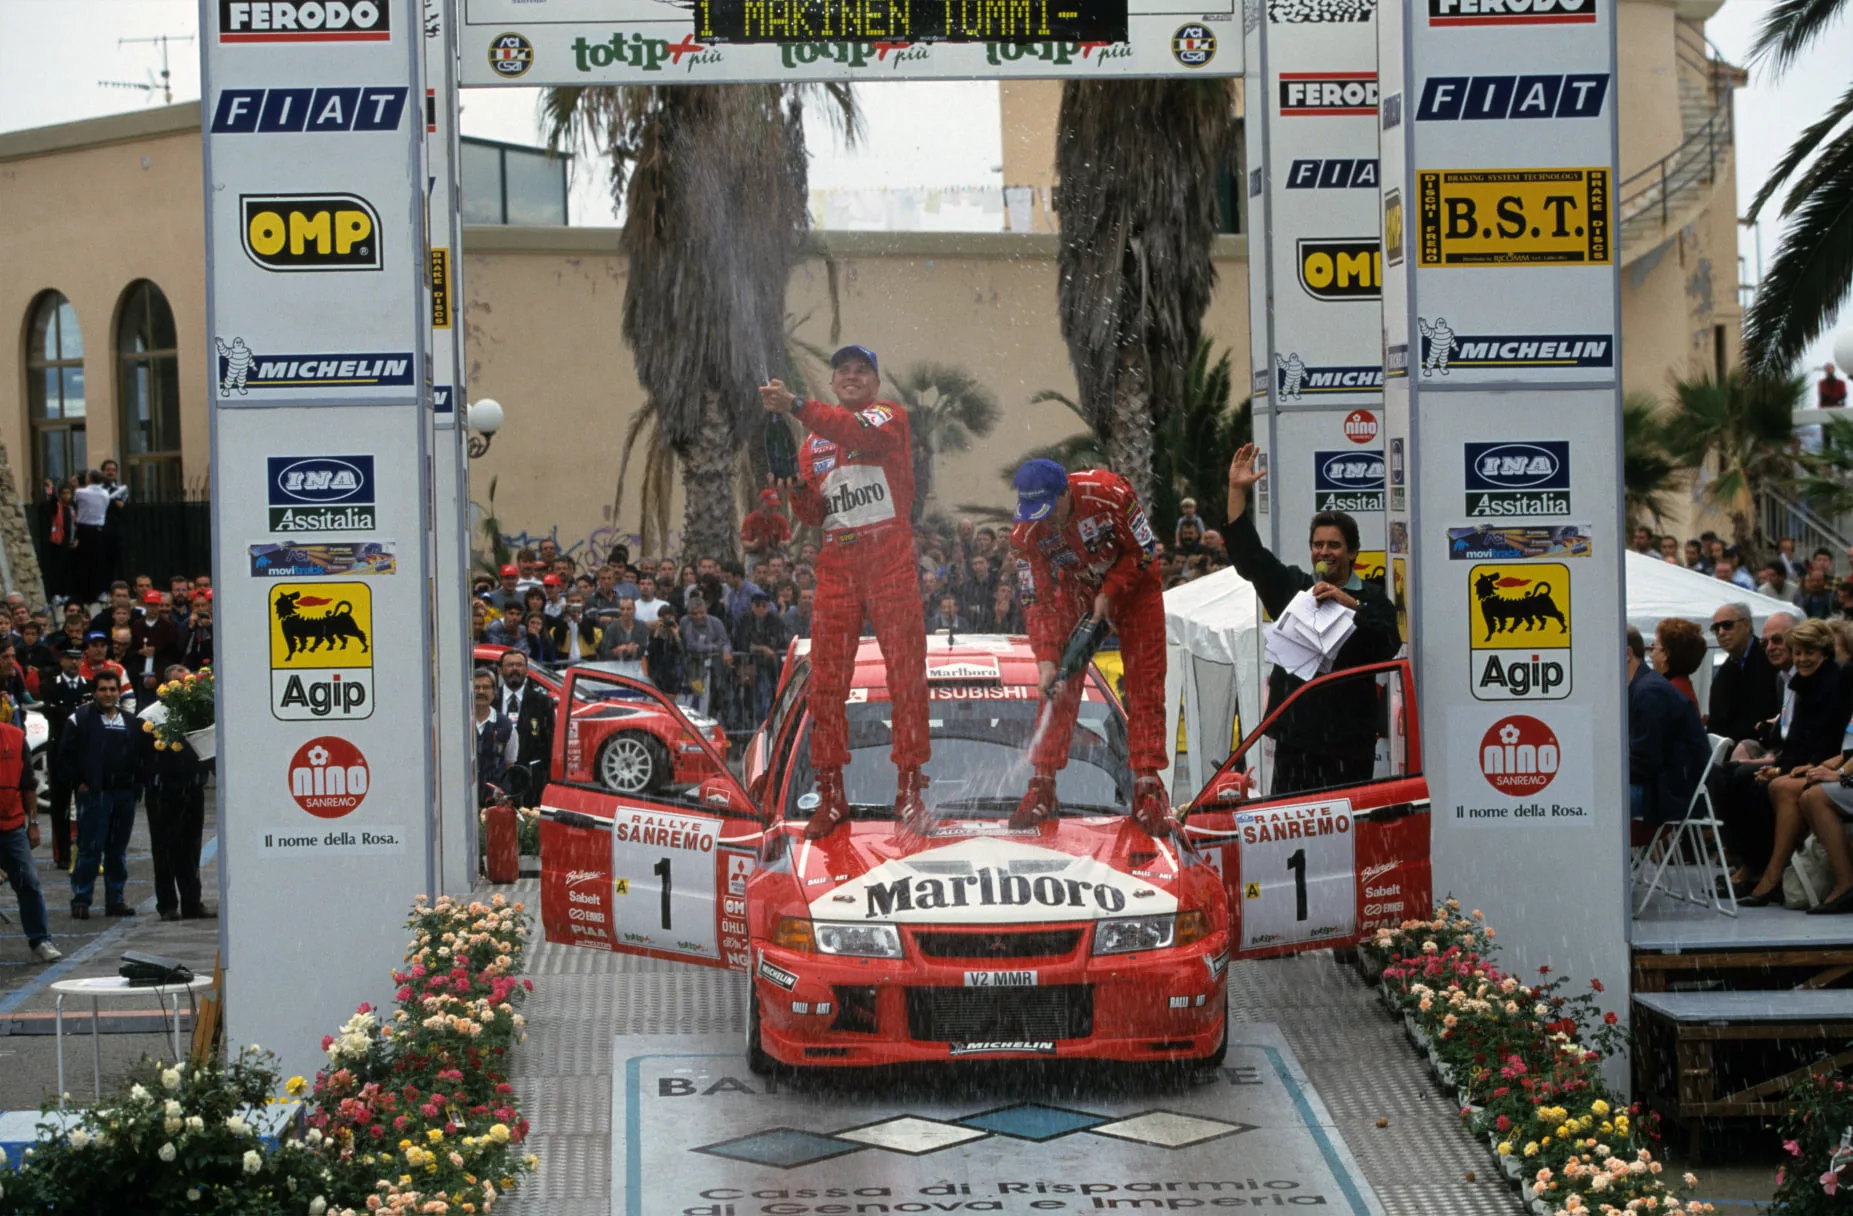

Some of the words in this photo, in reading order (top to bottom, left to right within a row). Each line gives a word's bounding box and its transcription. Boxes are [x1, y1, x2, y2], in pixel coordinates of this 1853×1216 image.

[229, 1, 380, 30] FERODO
[745, 0, 910, 36] MAKINEN
[1288, 83, 1378, 106] FEROD
[1430, 82, 1597, 113] FIAT
[226, 95, 395, 125] FIAT
[1296, 164, 1376, 184] FIA
[1447, 174, 1485, 182] BRAKING
[1488, 173, 1520, 181] SYSTEM
[1524, 172, 1579, 181] TECHNOLOGY
[1425, 175, 1436, 218] DISCHI
[1591, 172, 1602, 211] BRAKE
[1444, 195, 1584, 239] B.S.T.
[250, 211, 372, 256] OMP
[1426, 226, 1437, 262] FRENO
[1592, 220, 1603, 260] DISCS
[1304, 252, 1381, 287] OM
[1458, 341, 1607, 360] MICHELIN
[257, 359, 408, 379] MICHELIN
[1309, 371, 1383, 387] MICHE
[1481, 456, 1553, 475] INA
[285, 471, 357, 490] INA
[824, 482, 885, 516] arlboro
[1320, 493, 1383, 511] Assital
[1472, 493, 1568, 517] Assitalia
[275, 507, 373, 531] Assitalia
[929, 667, 997, 678] Marlboro
[1479, 654, 1564, 696] Agip
[280, 674, 366, 716] Agip
[929, 685, 1028, 700] TSUBISHI
[1484, 744, 1558, 774] nino
[292, 765, 368, 797] nino
[1496, 775, 1547, 786] SANREMO
[306, 797, 356, 808] SANREMO
[1456, 806, 1464, 818] Il
[1469, 808, 1508, 818] nome
[1514, 804, 1546, 817] della
[1552, 804, 1588, 817] Rosa.
[631, 814, 702, 831] RALLYE
[1254, 806, 1332, 824] RALLYE
[265, 834, 273, 848] Il
[278, 837, 318, 848] nome
[324, 833, 356, 846] della
[362, 832, 399, 845] Rosa.
[617, 823, 713, 852] SANREMO
[1243, 815, 1349, 844] SANREMO
[654, 857, 672, 930] 1
[864, 868, 1125, 918] Marlboro
[1287, 849, 1307, 921] 1
[1365, 884, 1401, 899] Sabelt
[568, 890, 601, 906] Sabelt
[725, 900, 745, 914] OM
[722, 917, 746, 934] ÖHLI
[727, 952, 749, 966] NG
[970, 972, 988, 985] V2
[993, 971, 1032, 985] MMR
[966, 1042, 1053, 1050] MICHELIN
[699, 1187, 891, 1200] Cassa
[918, 1183, 971, 1196] di
[997, 1179, 1300, 1195] Risparmio
[760, 1200, 1003, 1214] Genova
[1029, 1200, 1066, 1210] e
[1092, 1194, 1327, 1210] Imperia
